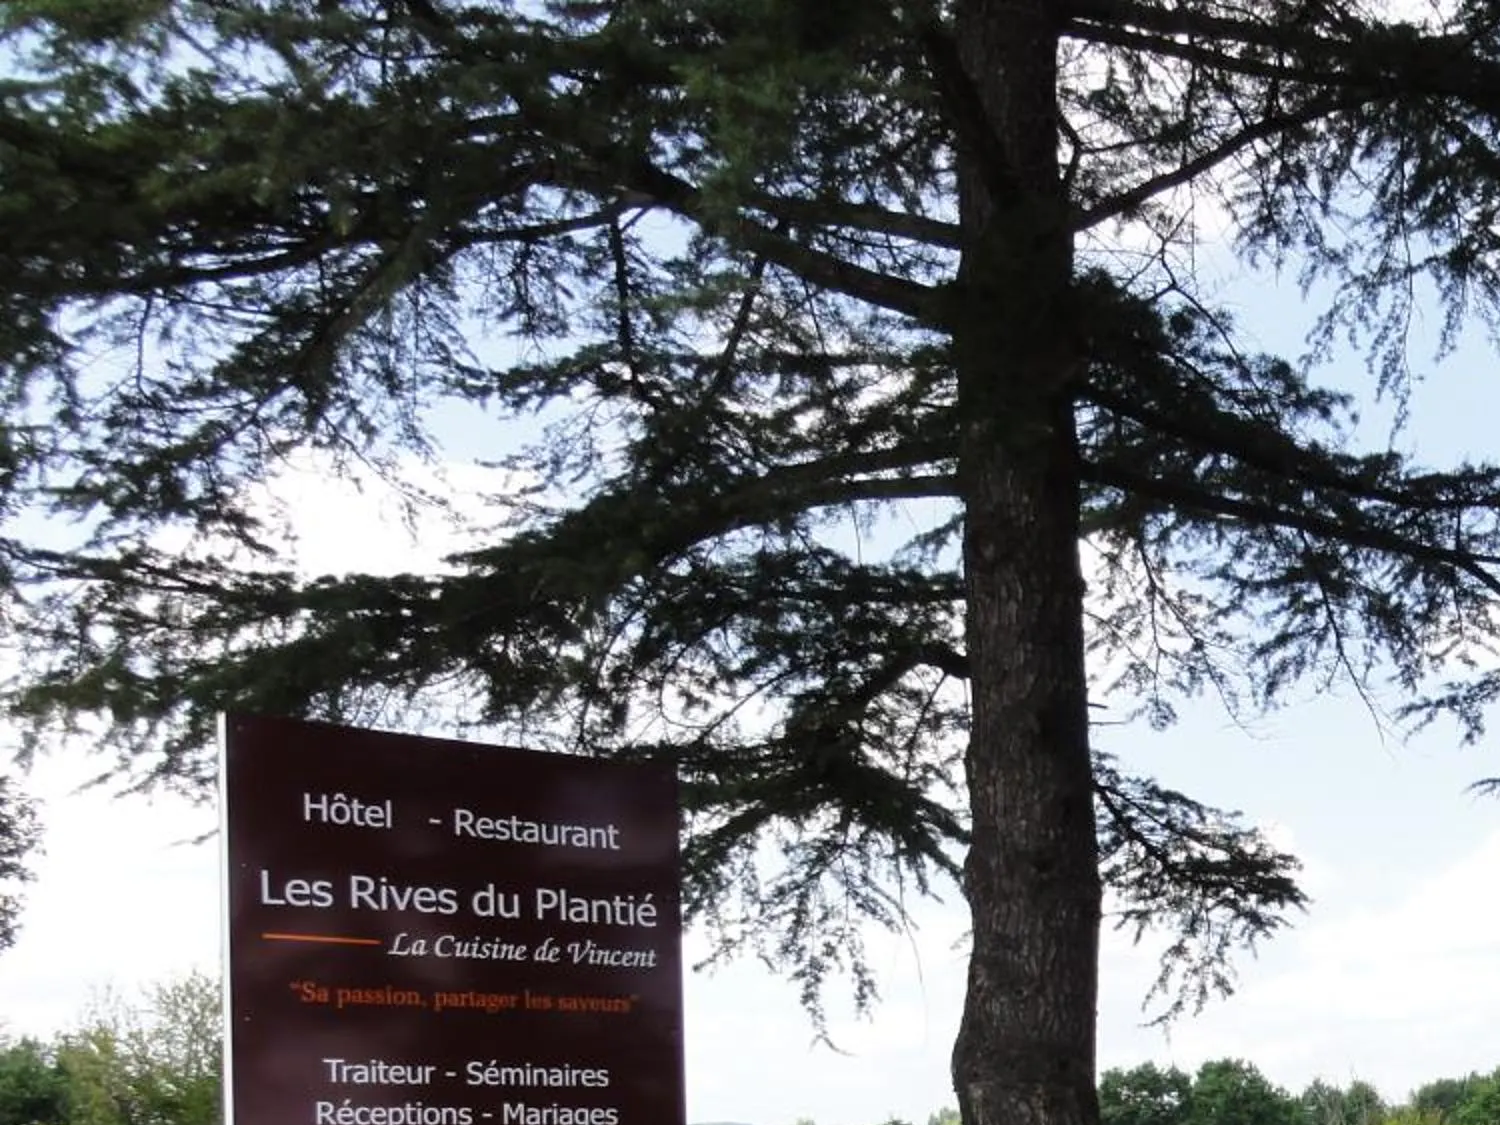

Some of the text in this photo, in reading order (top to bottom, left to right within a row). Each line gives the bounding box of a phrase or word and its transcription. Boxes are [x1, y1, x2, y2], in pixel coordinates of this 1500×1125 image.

[304, 793, 391, 828] Hôtel
[455, 809, 620, 850] Restaurant
[262, 870, 656, 927] Les Rives du Plantié
[388, 933, 656, 967] La Cuisine de Vincent
[434, 992, 518, 1011] partager
[525, 991, 553, 1009] les
[323, 1058, 435, 1084] Traiteur
[467, 1060, 608, 1086] Séminaires
